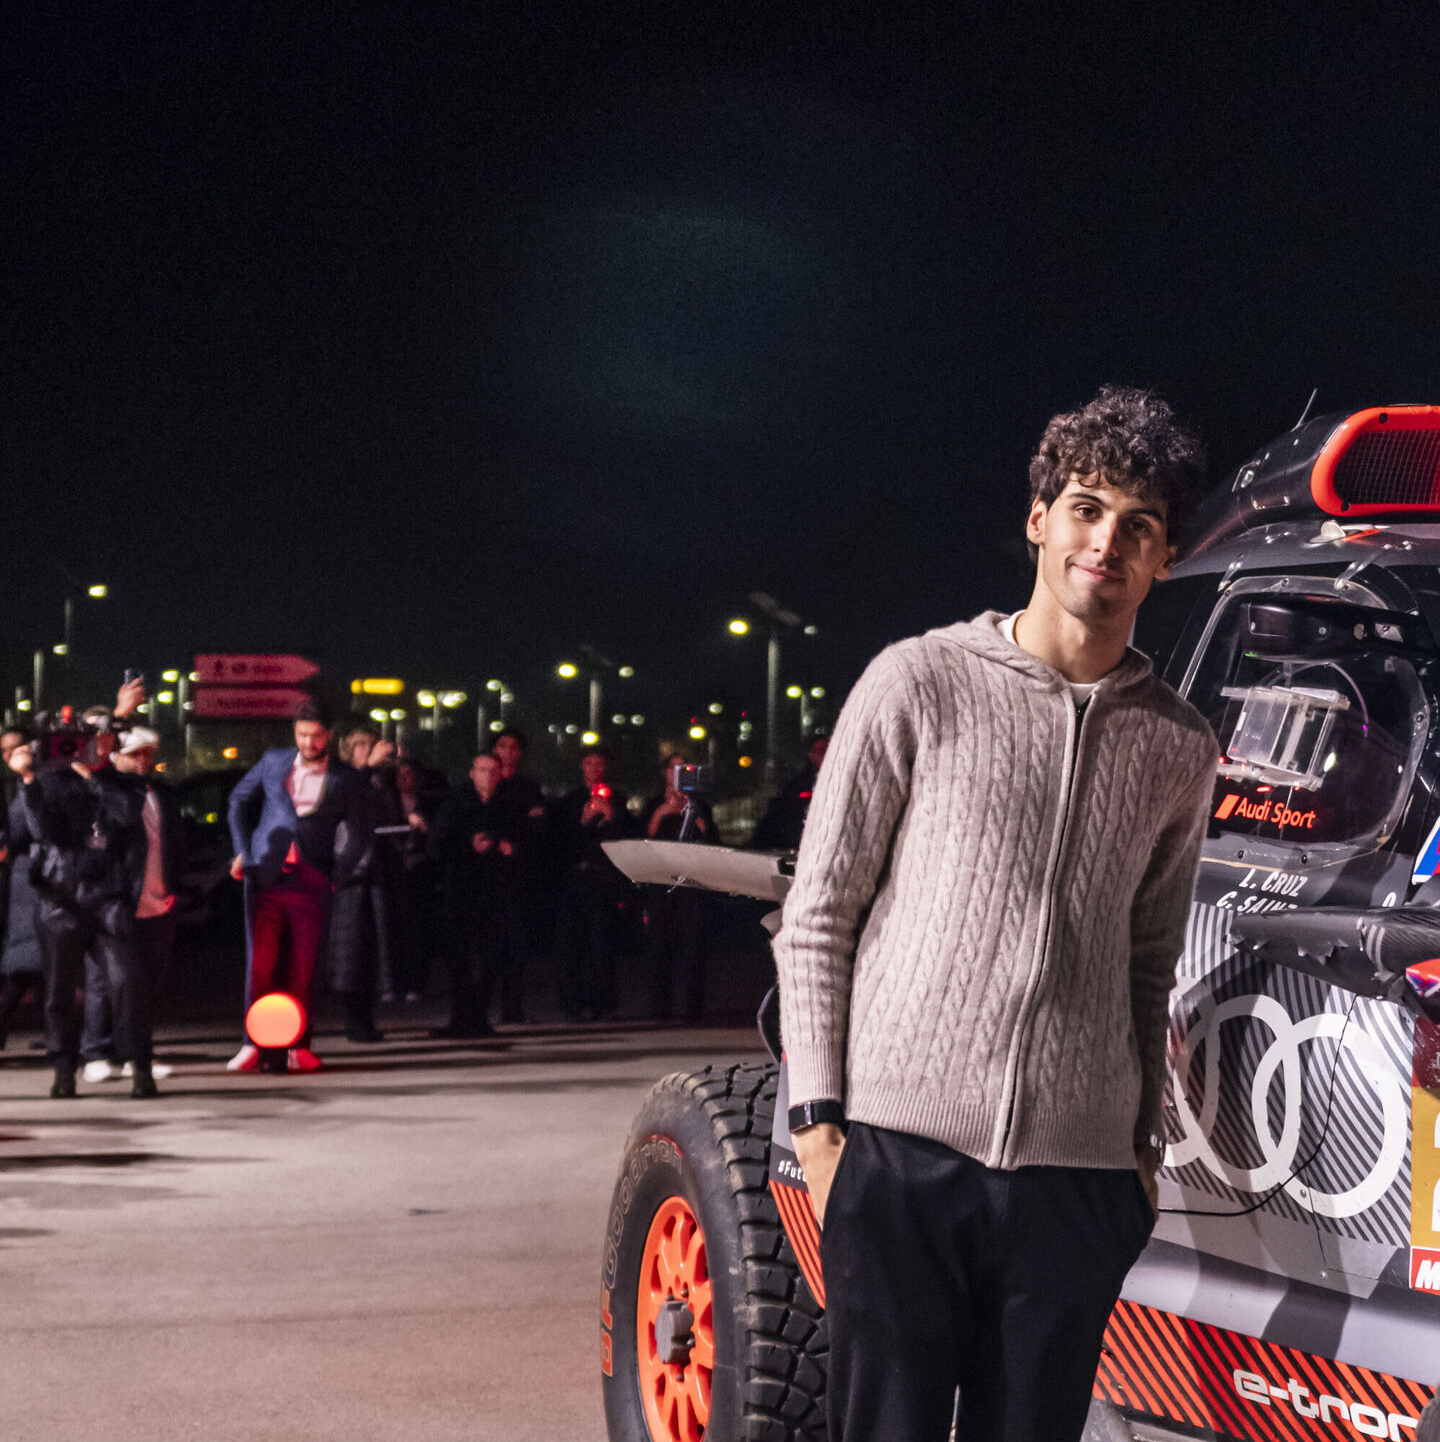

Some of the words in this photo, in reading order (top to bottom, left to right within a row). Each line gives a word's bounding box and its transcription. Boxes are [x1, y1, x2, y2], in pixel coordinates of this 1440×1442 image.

[1234, 796, 1272, 822] Audi
[1271, 802, 1317, 829] Sport
[1261, 870, 1309, 897] CRUZ
[1216, 890, 1238, 909] C.
[1237, 895, 1298, 914] SAIN
